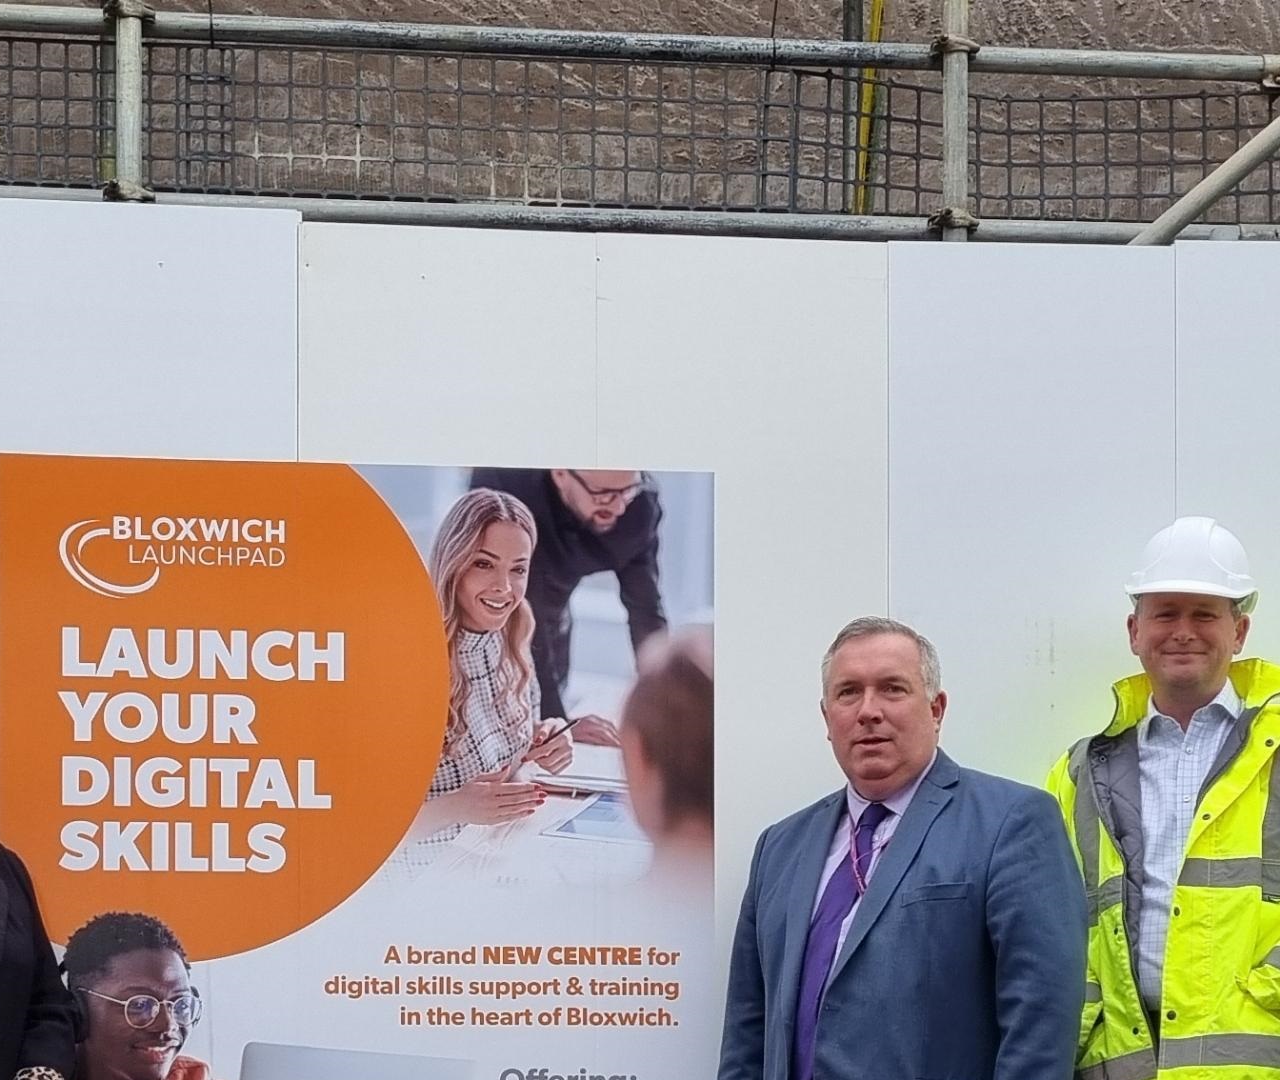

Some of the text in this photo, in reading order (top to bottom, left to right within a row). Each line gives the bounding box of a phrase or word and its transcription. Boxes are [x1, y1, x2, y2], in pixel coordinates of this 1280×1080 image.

[112, 515, 286, 544] BLOXWICH
[128, 544, 286, 567] LAUNCHPAD
[61, 626, 345, 682] LAUNCH
[57, 691, 259, 745] YOUR
[61, 755, 332, 809] DIGITAL
[58, 820, 287, 873] SKILLS
[384, 946, 680, 966] A brand NEW CENTRE for
[324, 976, 680, 1000] digital skills support & training
[400, 1007, 680, 1027] in the heart of Bloxwich.
